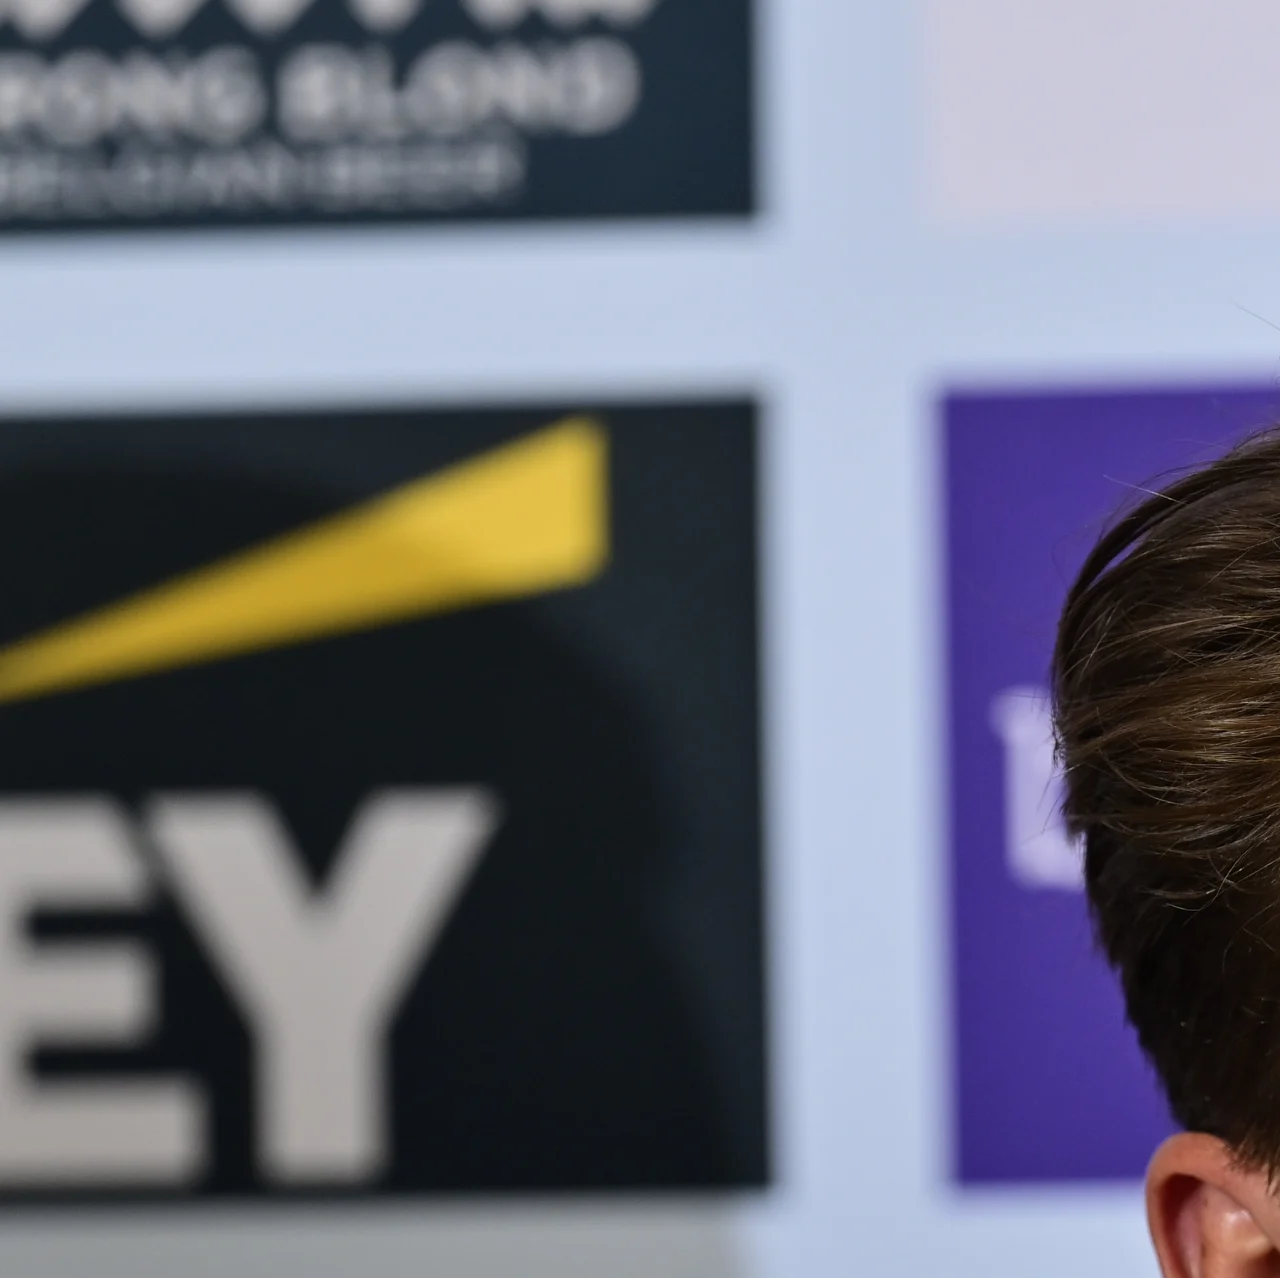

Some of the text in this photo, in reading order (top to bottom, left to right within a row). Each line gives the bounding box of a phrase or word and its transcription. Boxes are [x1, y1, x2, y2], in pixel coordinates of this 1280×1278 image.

[279, 38, 642, 140] BLOND
[310, 138, 524, 206] BEER
[0, 788, 500, 1185] EY
